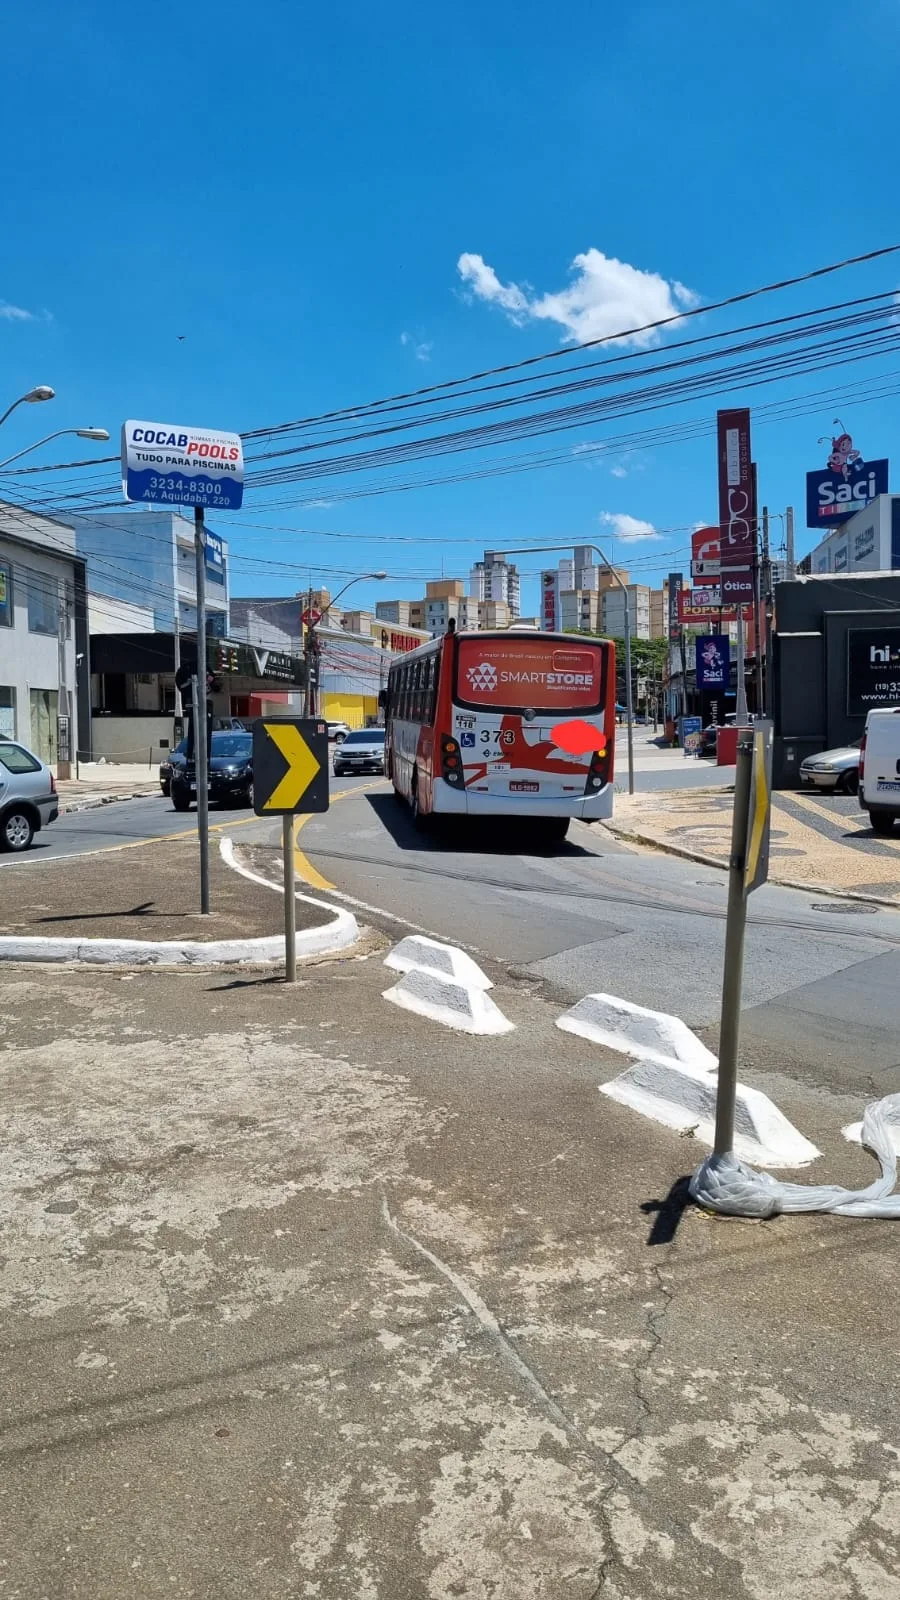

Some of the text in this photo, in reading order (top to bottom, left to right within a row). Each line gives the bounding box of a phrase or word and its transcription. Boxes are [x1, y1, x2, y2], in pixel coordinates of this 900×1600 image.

[132, 429, 188, 447] COCAB
[187, 442, 240, 461] POOLS
[136, 453, 237, 472] TUDO PARA PISCINAS
[150, 477, 222, 495] 3234-8300
[818, 471, 876, 505] Saci
[142, 489, 158, 499] Av.
[213, 496, 230, 505] 220
[724, 580, 752, 591] Ótica
[501, 672, 593, 686] SMARTSTORE
[703, 668, 723, 678] Saci
[710, 700, 718, 726] uvinil
[480, 730, 515, 744] 373
